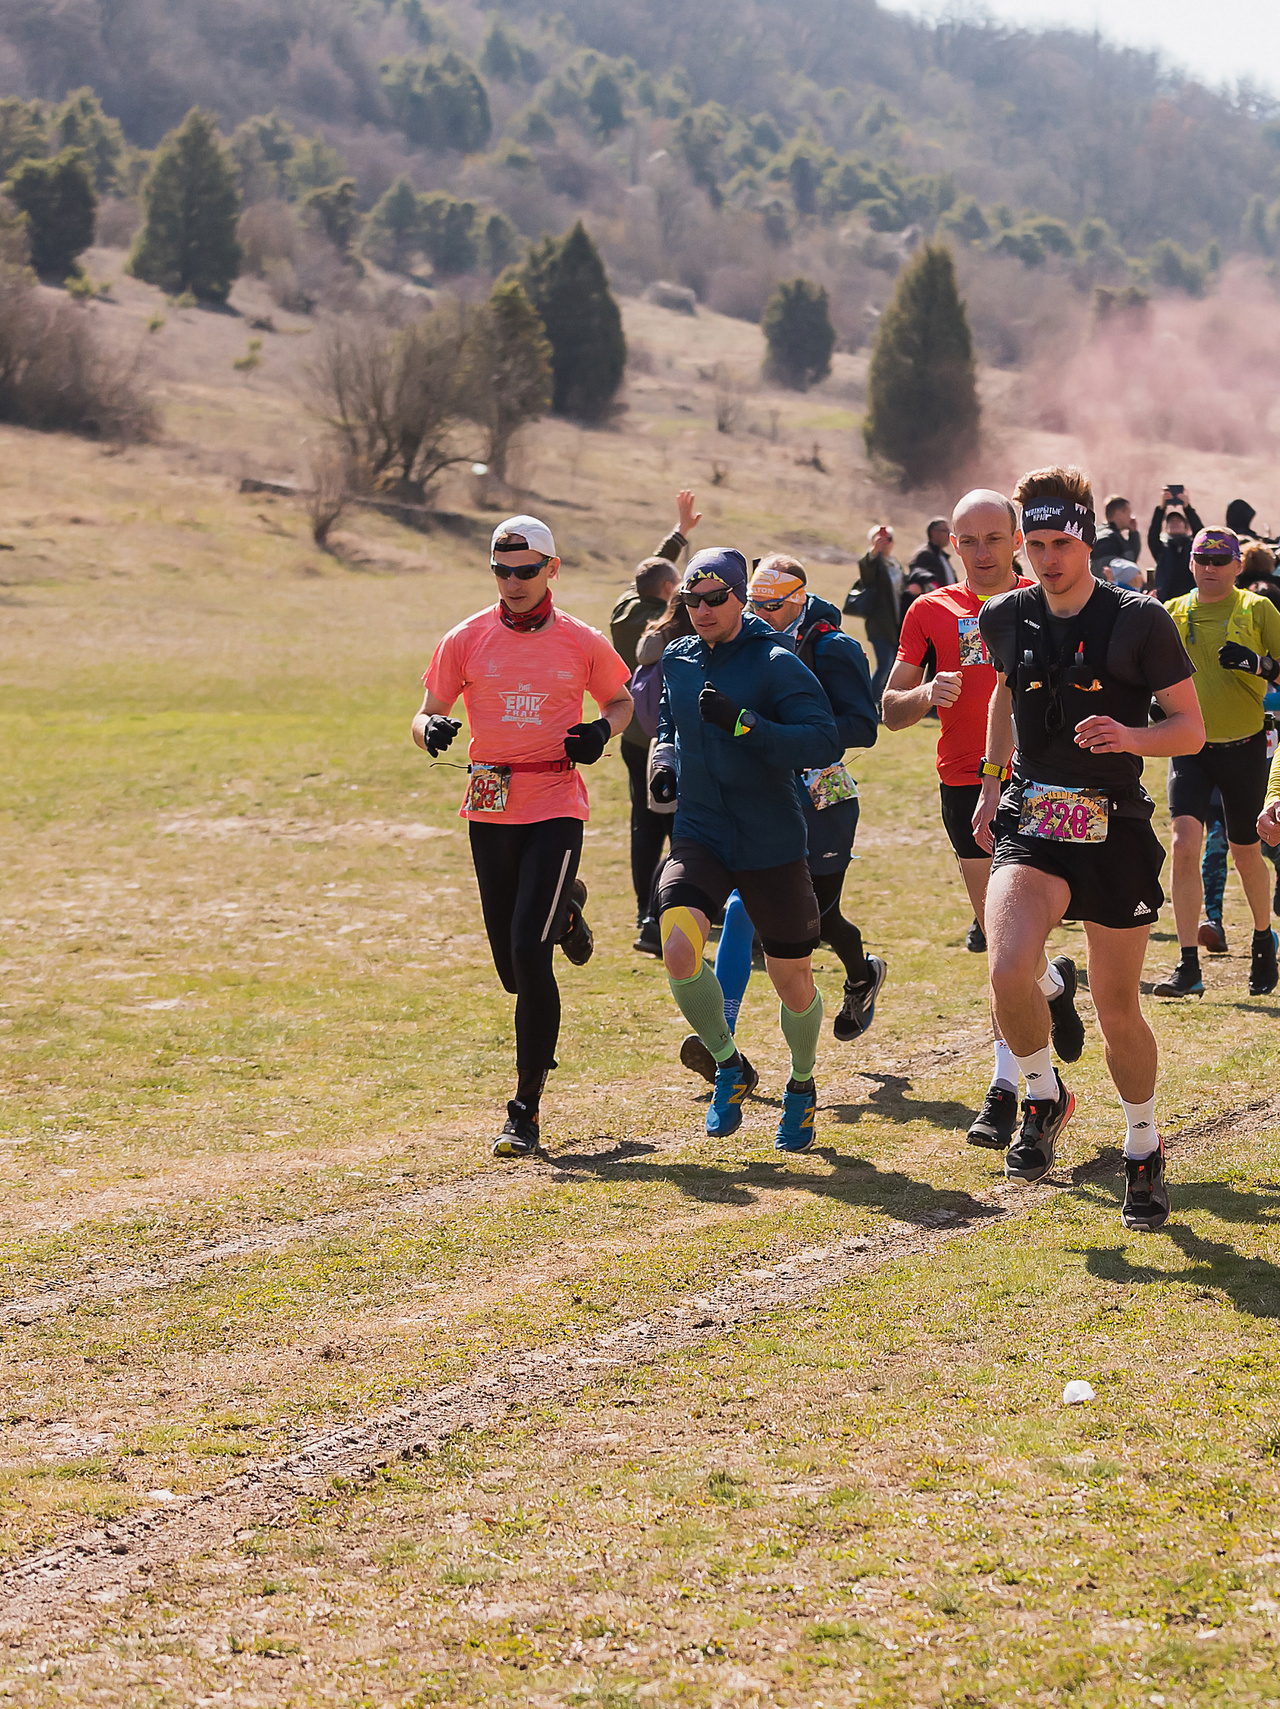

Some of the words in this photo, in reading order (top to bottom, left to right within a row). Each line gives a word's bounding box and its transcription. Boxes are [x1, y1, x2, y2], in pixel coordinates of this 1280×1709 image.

[506, 695, 541, 711] EPIC
[505, 709, 540, 717] TRAIL
[1037, 800, 1087, 838] 228
